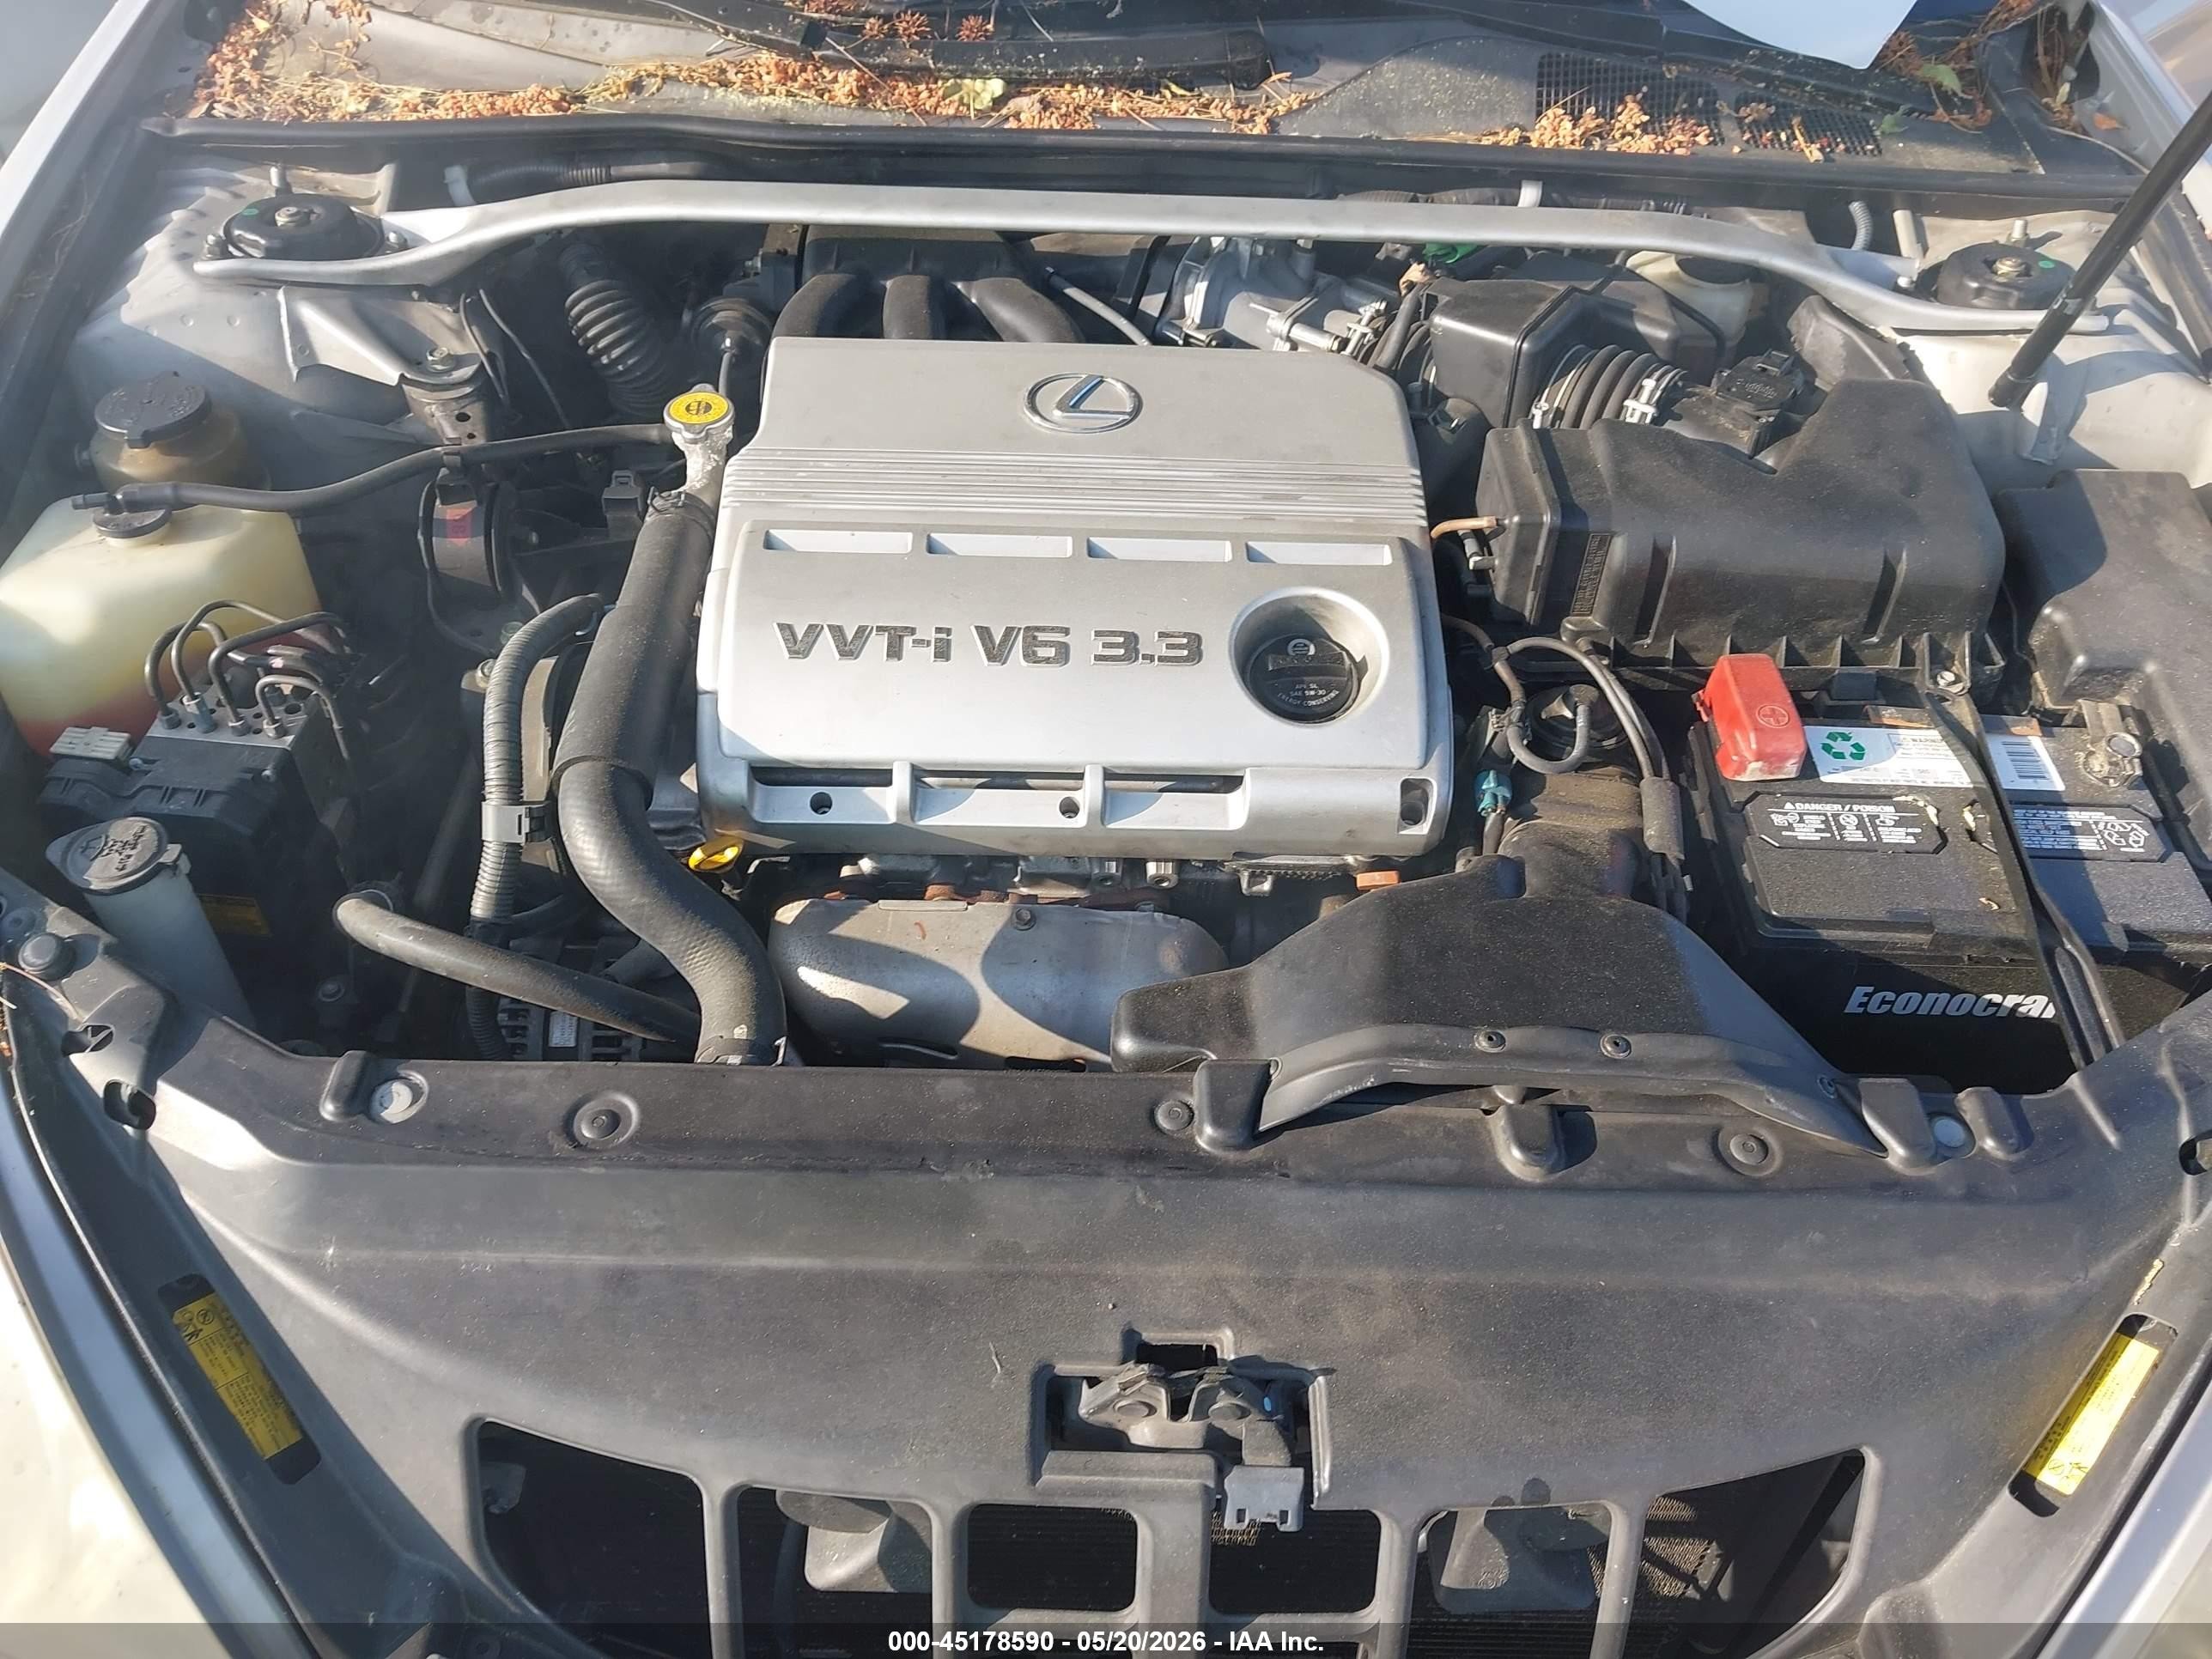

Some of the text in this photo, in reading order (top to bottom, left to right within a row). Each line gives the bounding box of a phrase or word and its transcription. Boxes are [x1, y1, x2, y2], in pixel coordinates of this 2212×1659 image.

[773, 622, 1202, 667] VVT-i V6 3.3
[1302, 690, 1340, 707] CONSERVING
[1795, 802, 1843, 812] DANGER
[1851, 804, 1896, 814] POISON
